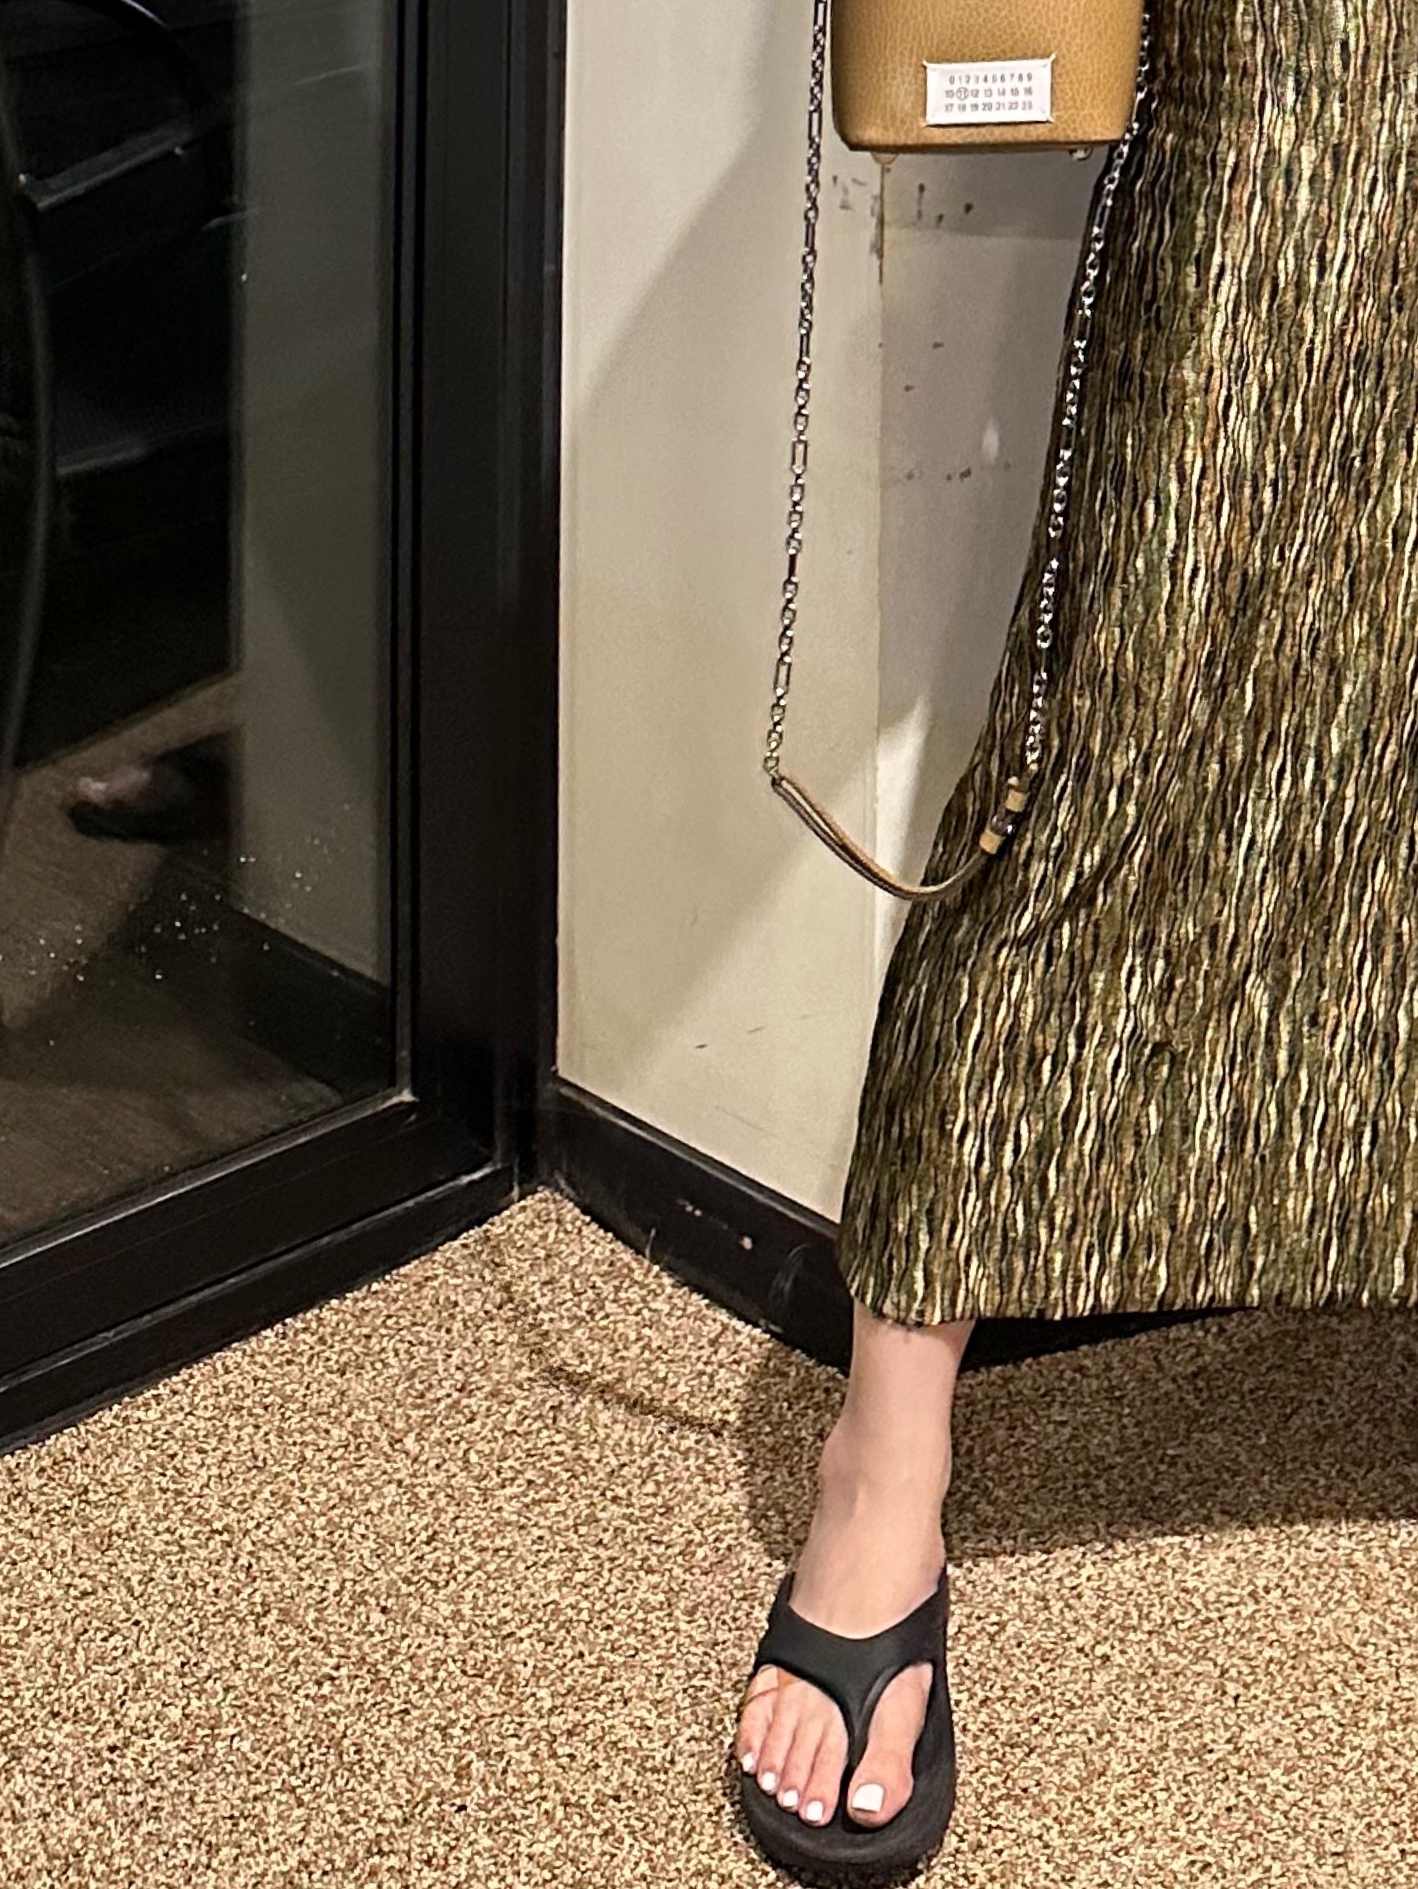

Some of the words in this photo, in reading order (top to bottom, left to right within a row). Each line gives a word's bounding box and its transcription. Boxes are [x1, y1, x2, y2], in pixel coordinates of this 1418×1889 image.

[997, 88, 1005, 97] 14
[945, 103, 954, 112] 17
[970, 103, 978, 111] 19
[982, 102, 992, 111] 20
[996, 102, 1005, 110] 21
